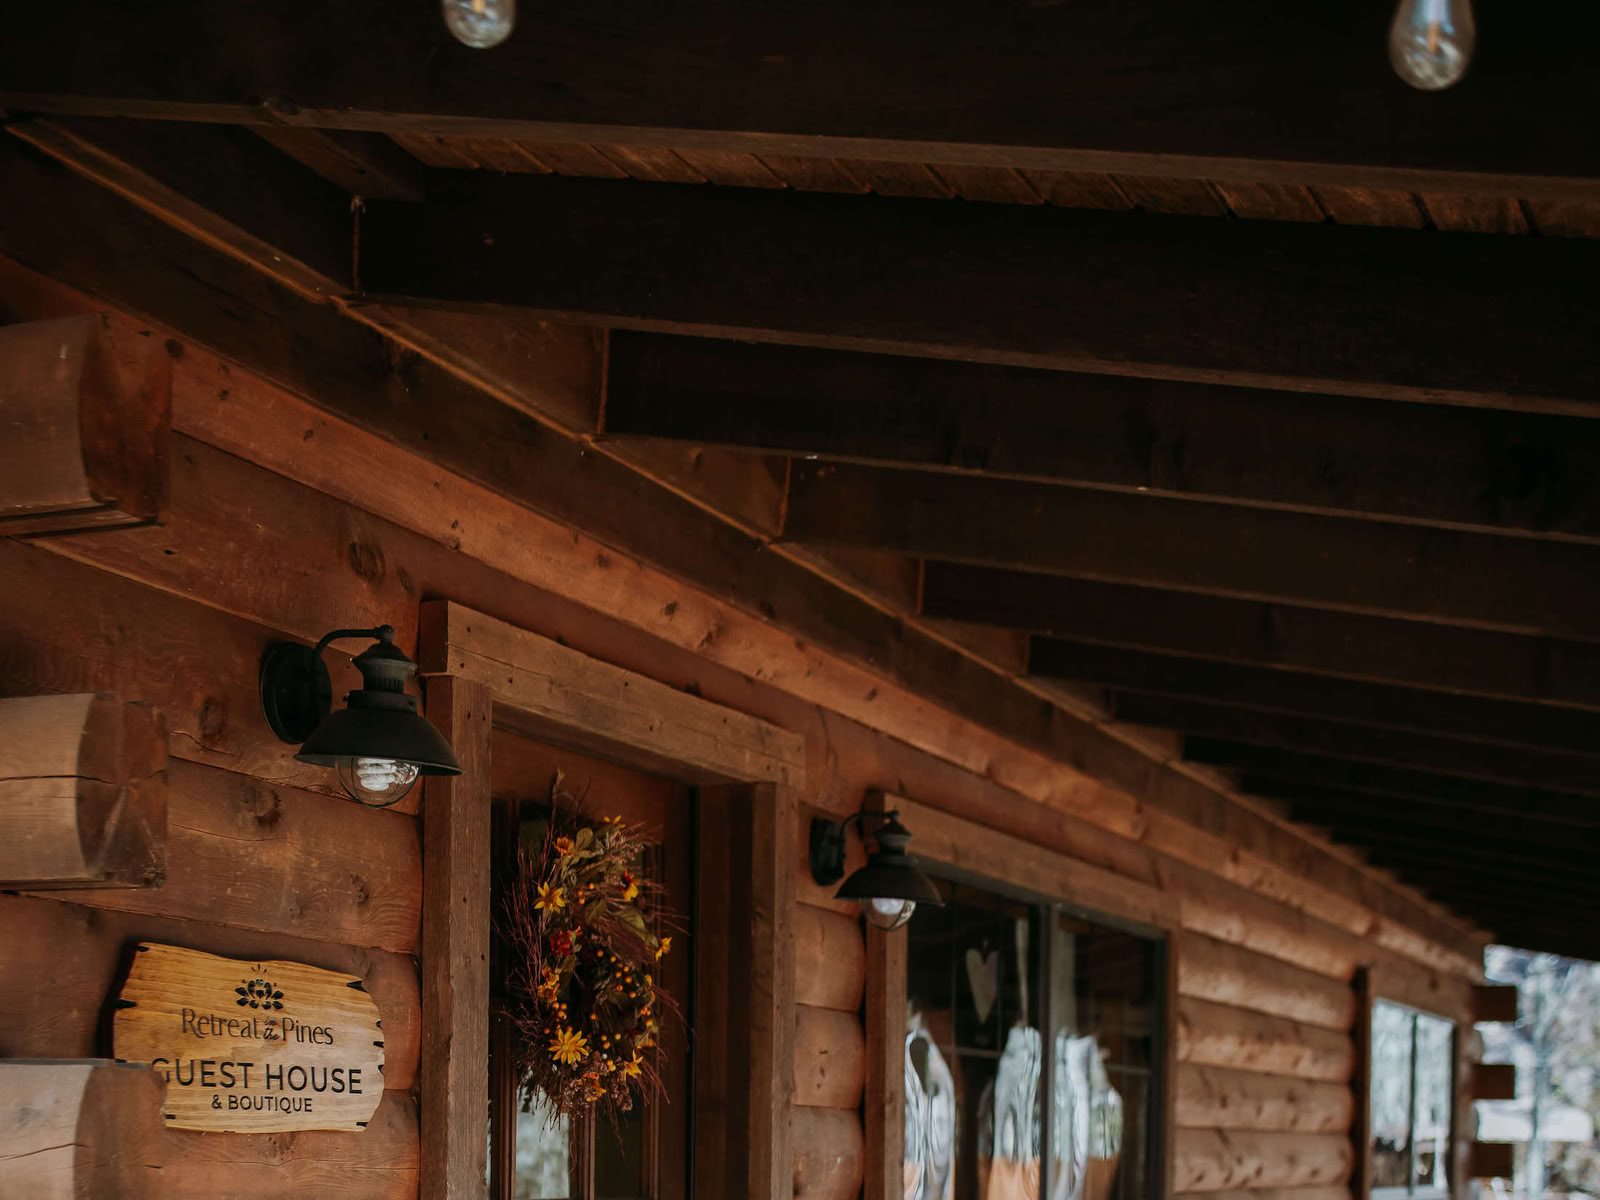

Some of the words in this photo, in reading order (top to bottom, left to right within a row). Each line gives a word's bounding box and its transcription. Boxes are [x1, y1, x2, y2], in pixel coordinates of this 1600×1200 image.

[181, 1007, 260, 1039] Retreat
[263, 1026, 280, 1041] the
[282, 1016, 334, 1045] Pines
[266, 1063, 362, 1094] HOUSE
[211, 1094, 223, 1110] &
[228, 1094, 313, 1114] BOUTIQUE
